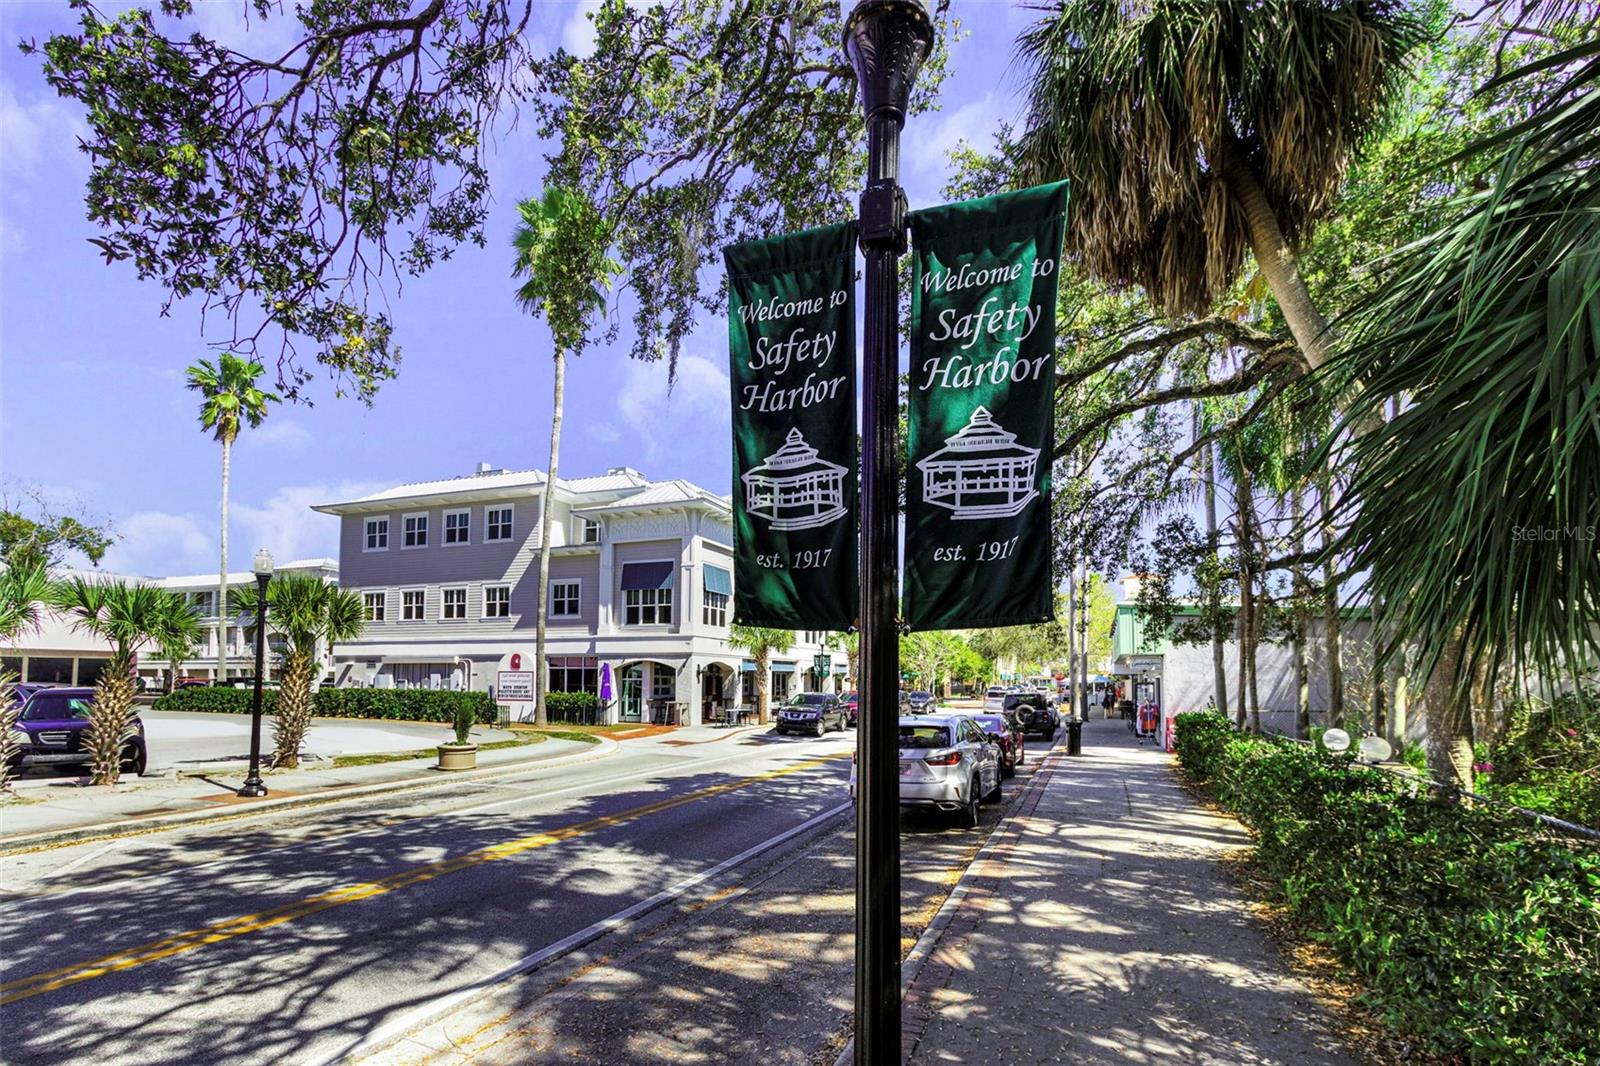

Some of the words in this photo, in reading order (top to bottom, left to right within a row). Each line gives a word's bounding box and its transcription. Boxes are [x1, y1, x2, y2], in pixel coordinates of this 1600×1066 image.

[920, 262, 1023, 294] Welcome
[1031, 257, 1055, 278] to
[738, 295, 824, 324] Welcome
[830, 290, 848, 309] to
[929, 296, 1042, 350] Safety
[748, 327, 837, 376] Safety
[918, 346, 1051, 391] Harbor
[739, 372, 847, 413] Harbor
[756, 551, 784, 569] est.
[792, 548, 833, 569] 1917
[933, 544, 967, 562] est.
[976, 535, 1019, 562] 1917
